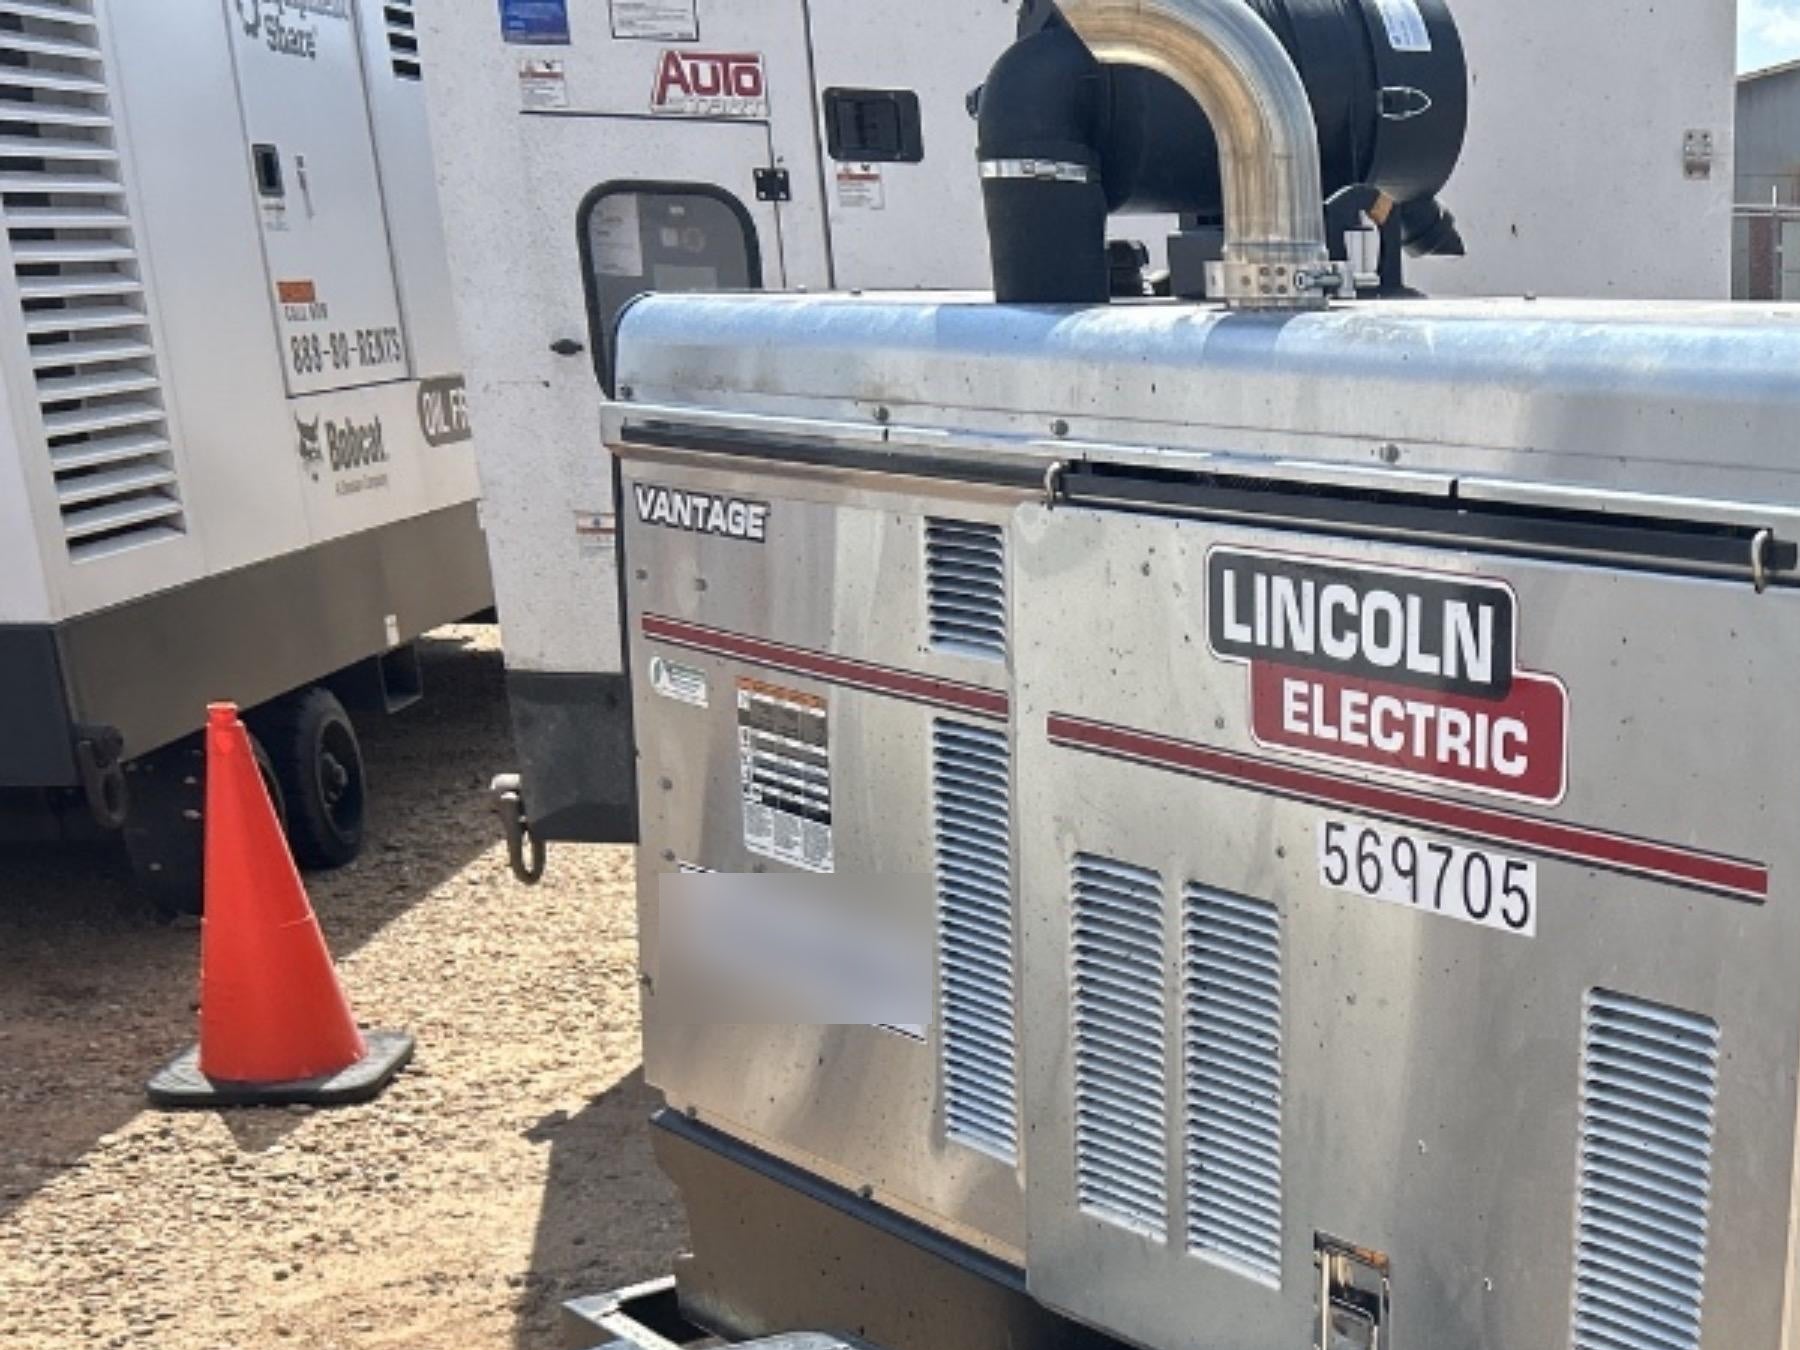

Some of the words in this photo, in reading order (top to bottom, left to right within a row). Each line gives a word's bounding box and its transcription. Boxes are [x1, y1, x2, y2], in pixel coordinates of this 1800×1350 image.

[325, 414, 388, 472] Bobcat
[633, 482, 768, 544] VANTAGE
[1222, 568, 1495, 684] LINCOLN
[1282, 677, 1530, 779] ELECTRIC
[1321, 820, 1532, 930] 569705
